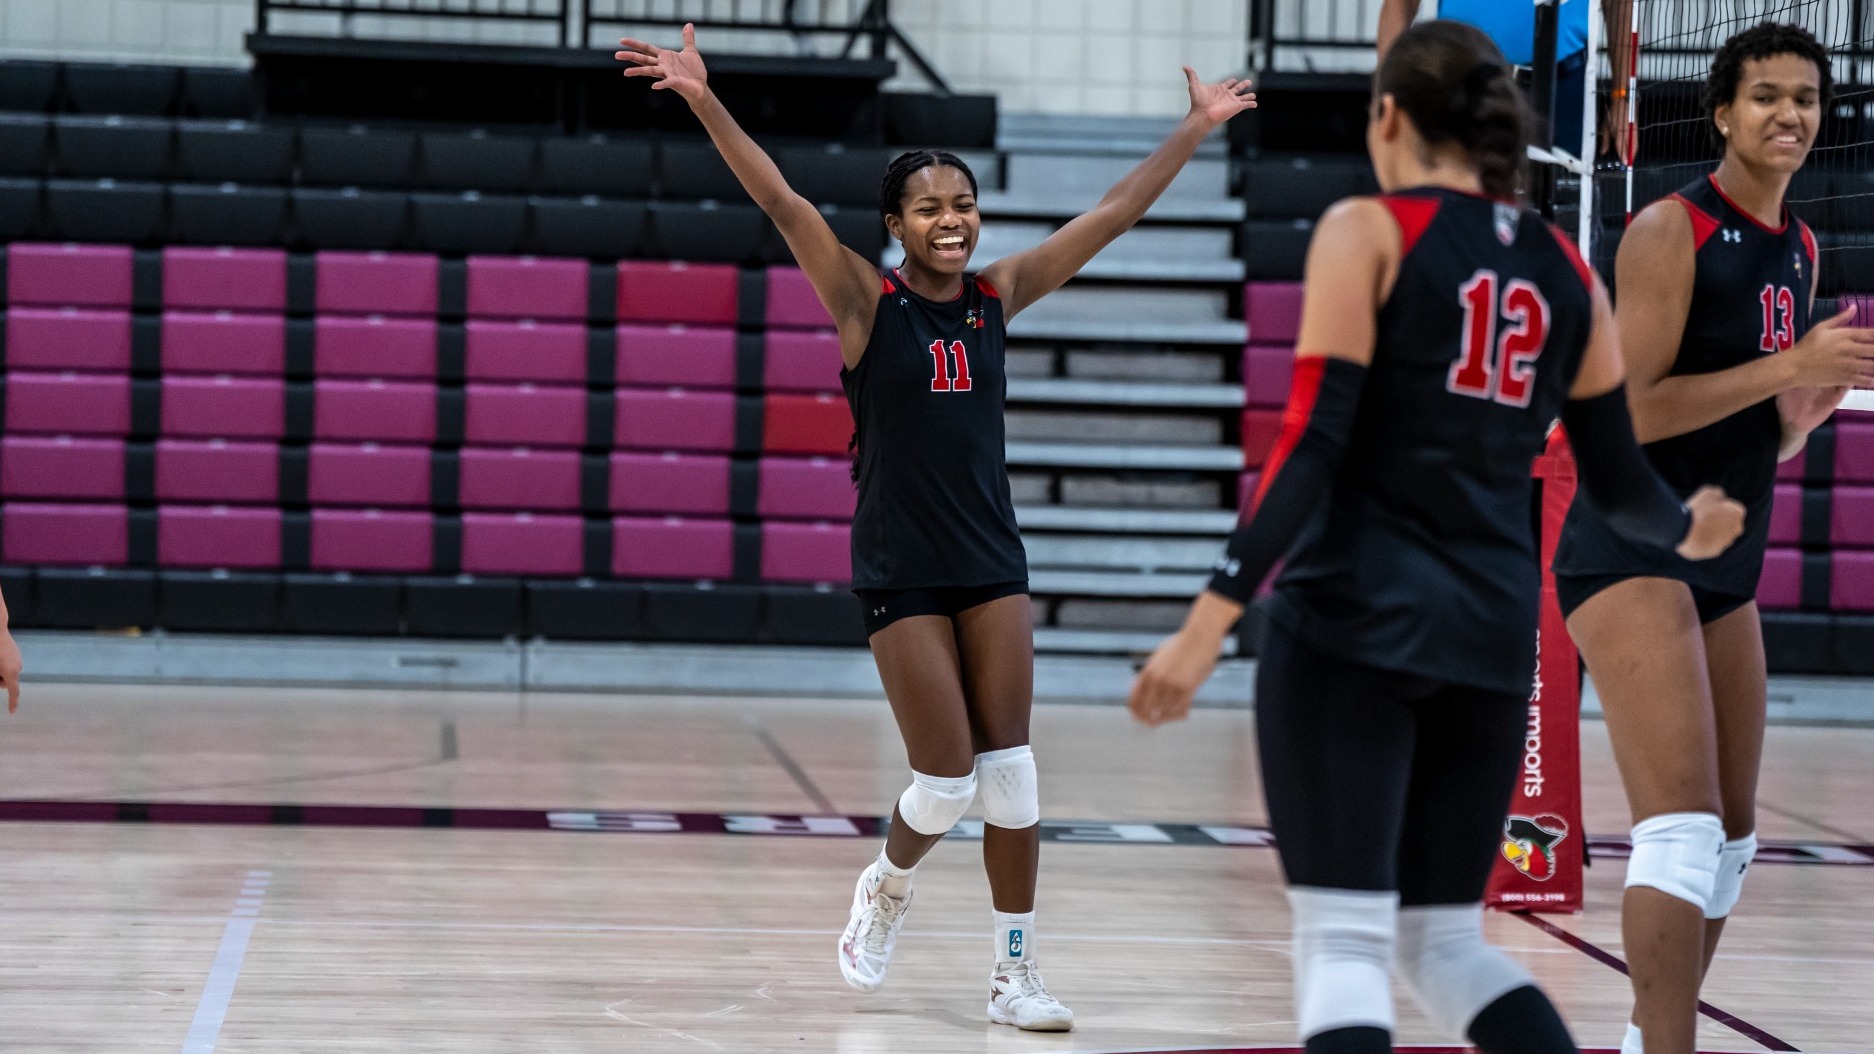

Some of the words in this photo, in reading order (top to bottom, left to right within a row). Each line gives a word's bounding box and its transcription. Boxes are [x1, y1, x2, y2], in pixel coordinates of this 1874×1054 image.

[1446, 268, 1551, 409] 12
[1759, 283, 1796, 353] 13
[929, 339, 972, 392] 11
[1524, 705, 1545, 797] imports
[1501, 893, 1524, 902] (800)
